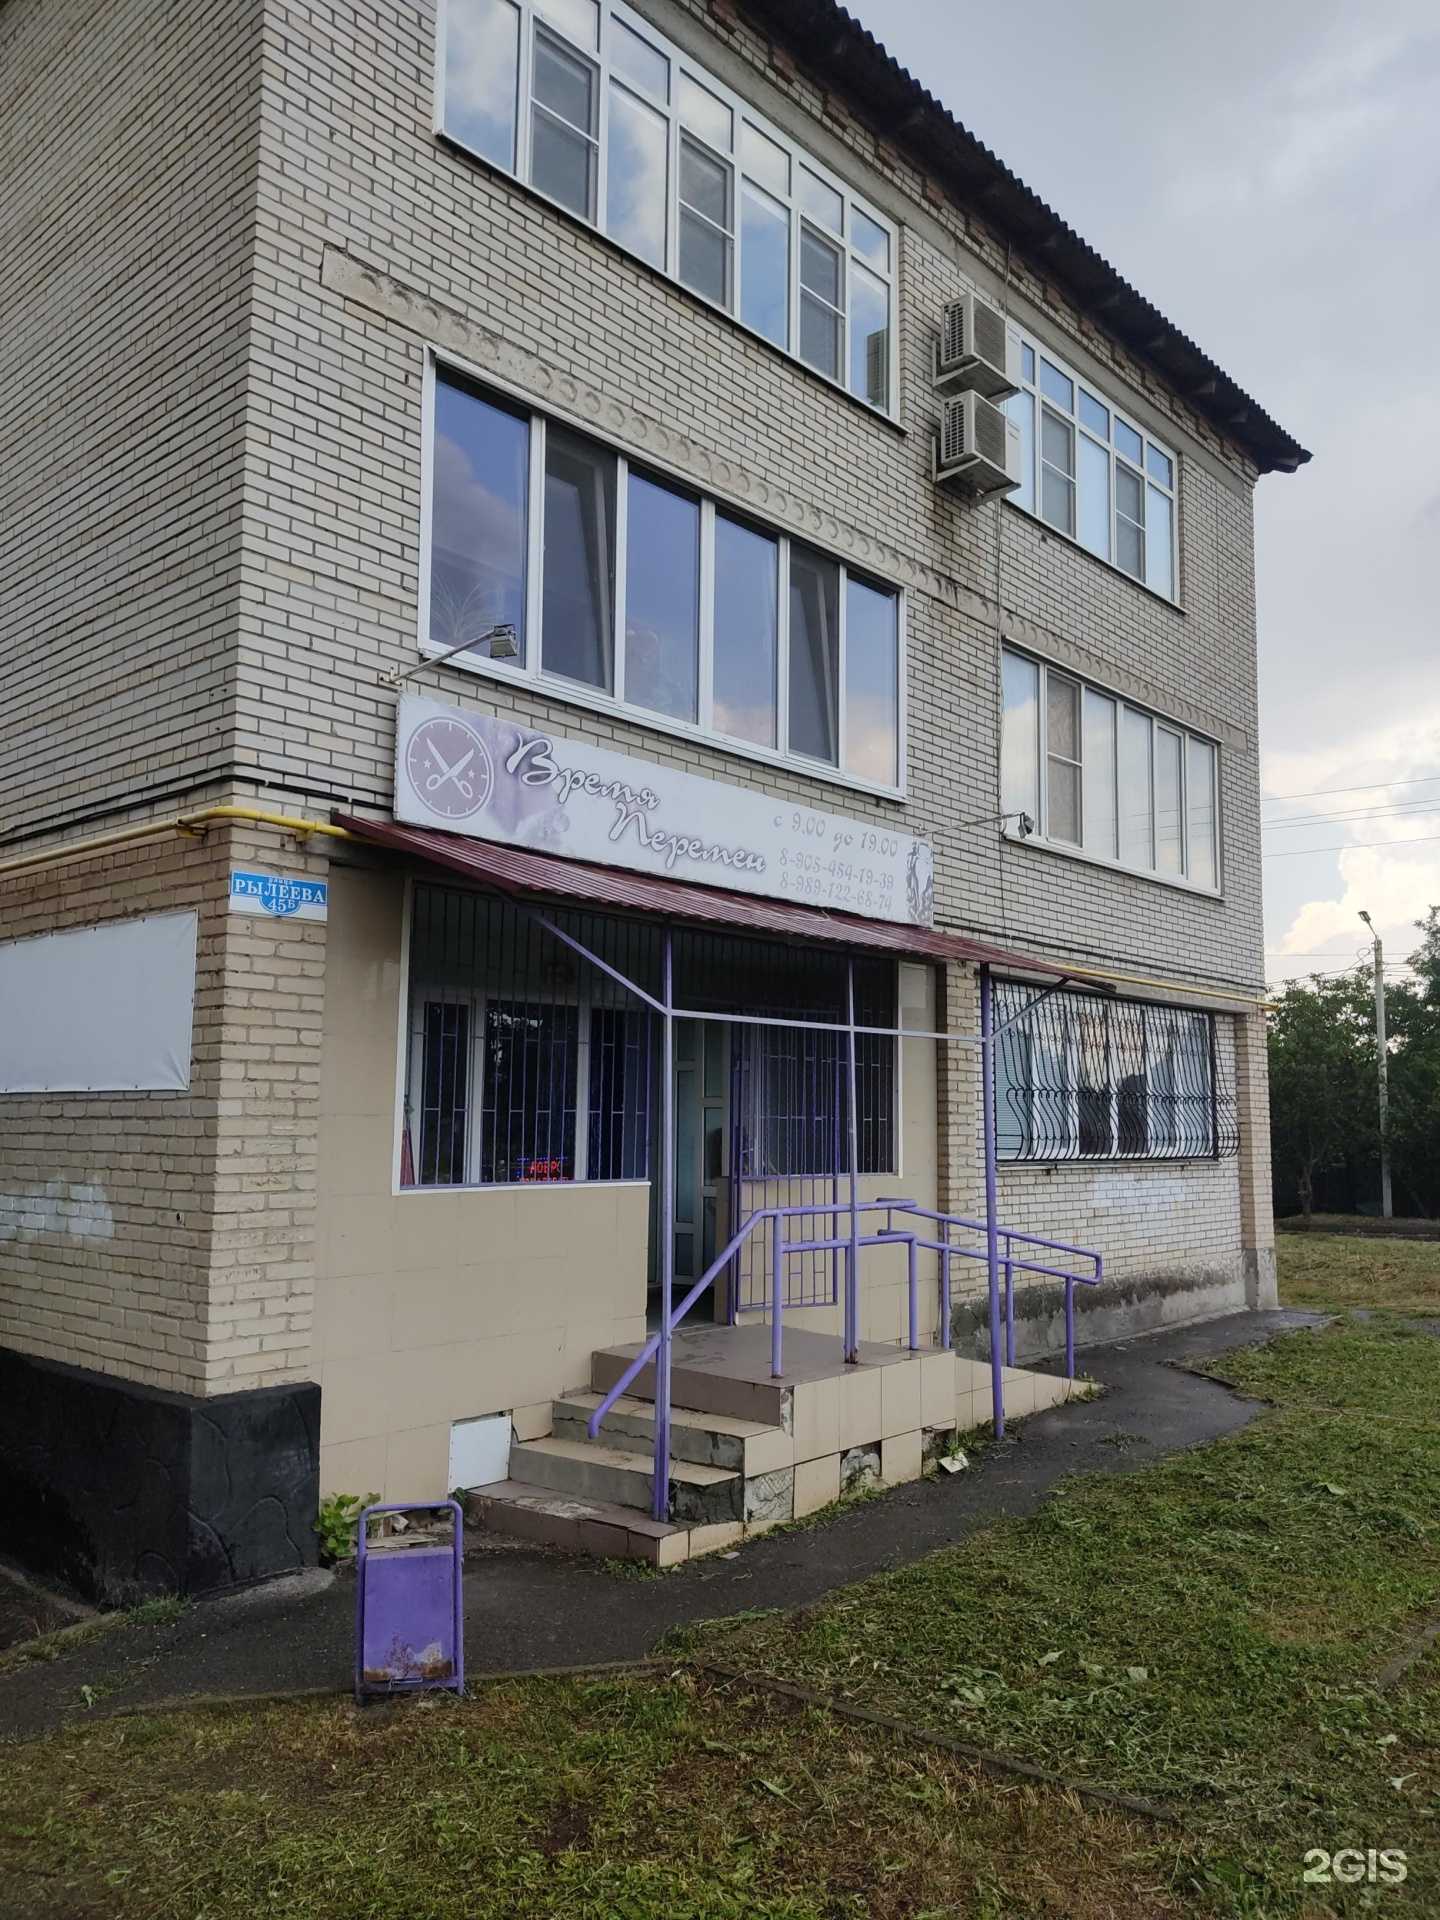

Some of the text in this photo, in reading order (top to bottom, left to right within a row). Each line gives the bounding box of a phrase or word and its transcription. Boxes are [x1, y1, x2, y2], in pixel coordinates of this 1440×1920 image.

[506, 732, 661, 810] Время
[608, 801, 766, 873] Перемен
[792, 812, 826, 838] 9.00
[860, 831, 898, 857] 19.00
[234, 878, 325, 903] РЫЛЕЕВА
